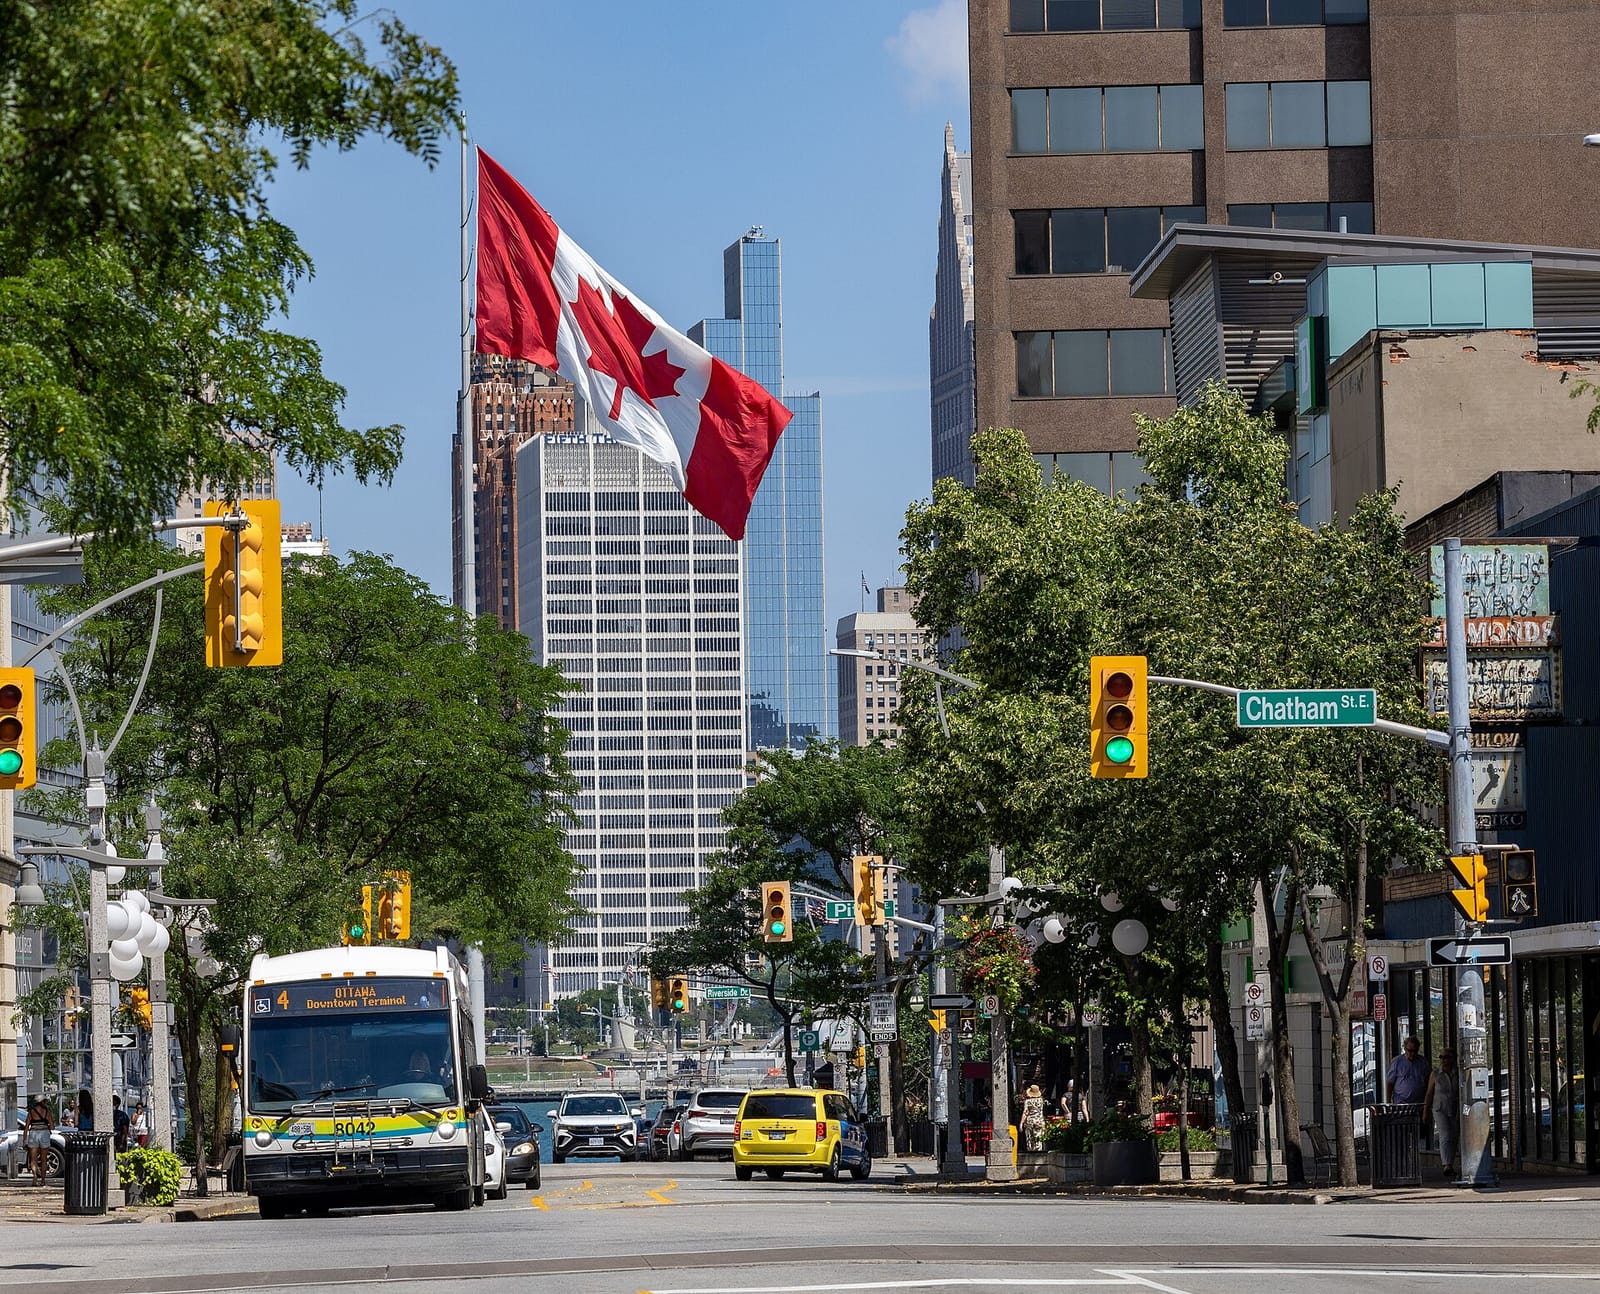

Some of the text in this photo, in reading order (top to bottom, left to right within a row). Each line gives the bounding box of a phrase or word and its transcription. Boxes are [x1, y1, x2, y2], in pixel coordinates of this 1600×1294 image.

[544, 433, 587, 444] FIFTH
[1246, 696, 1338, 720] Chatham
[835, 903, 855, 918] Pi
[276, 986, 376, 1010] 4 OTTAWA
[706, 988, 739, 998] Riverside
[306, 994, 407, 1010] Downtown Terminal
[335, 1121, 376, 1137] 8042
